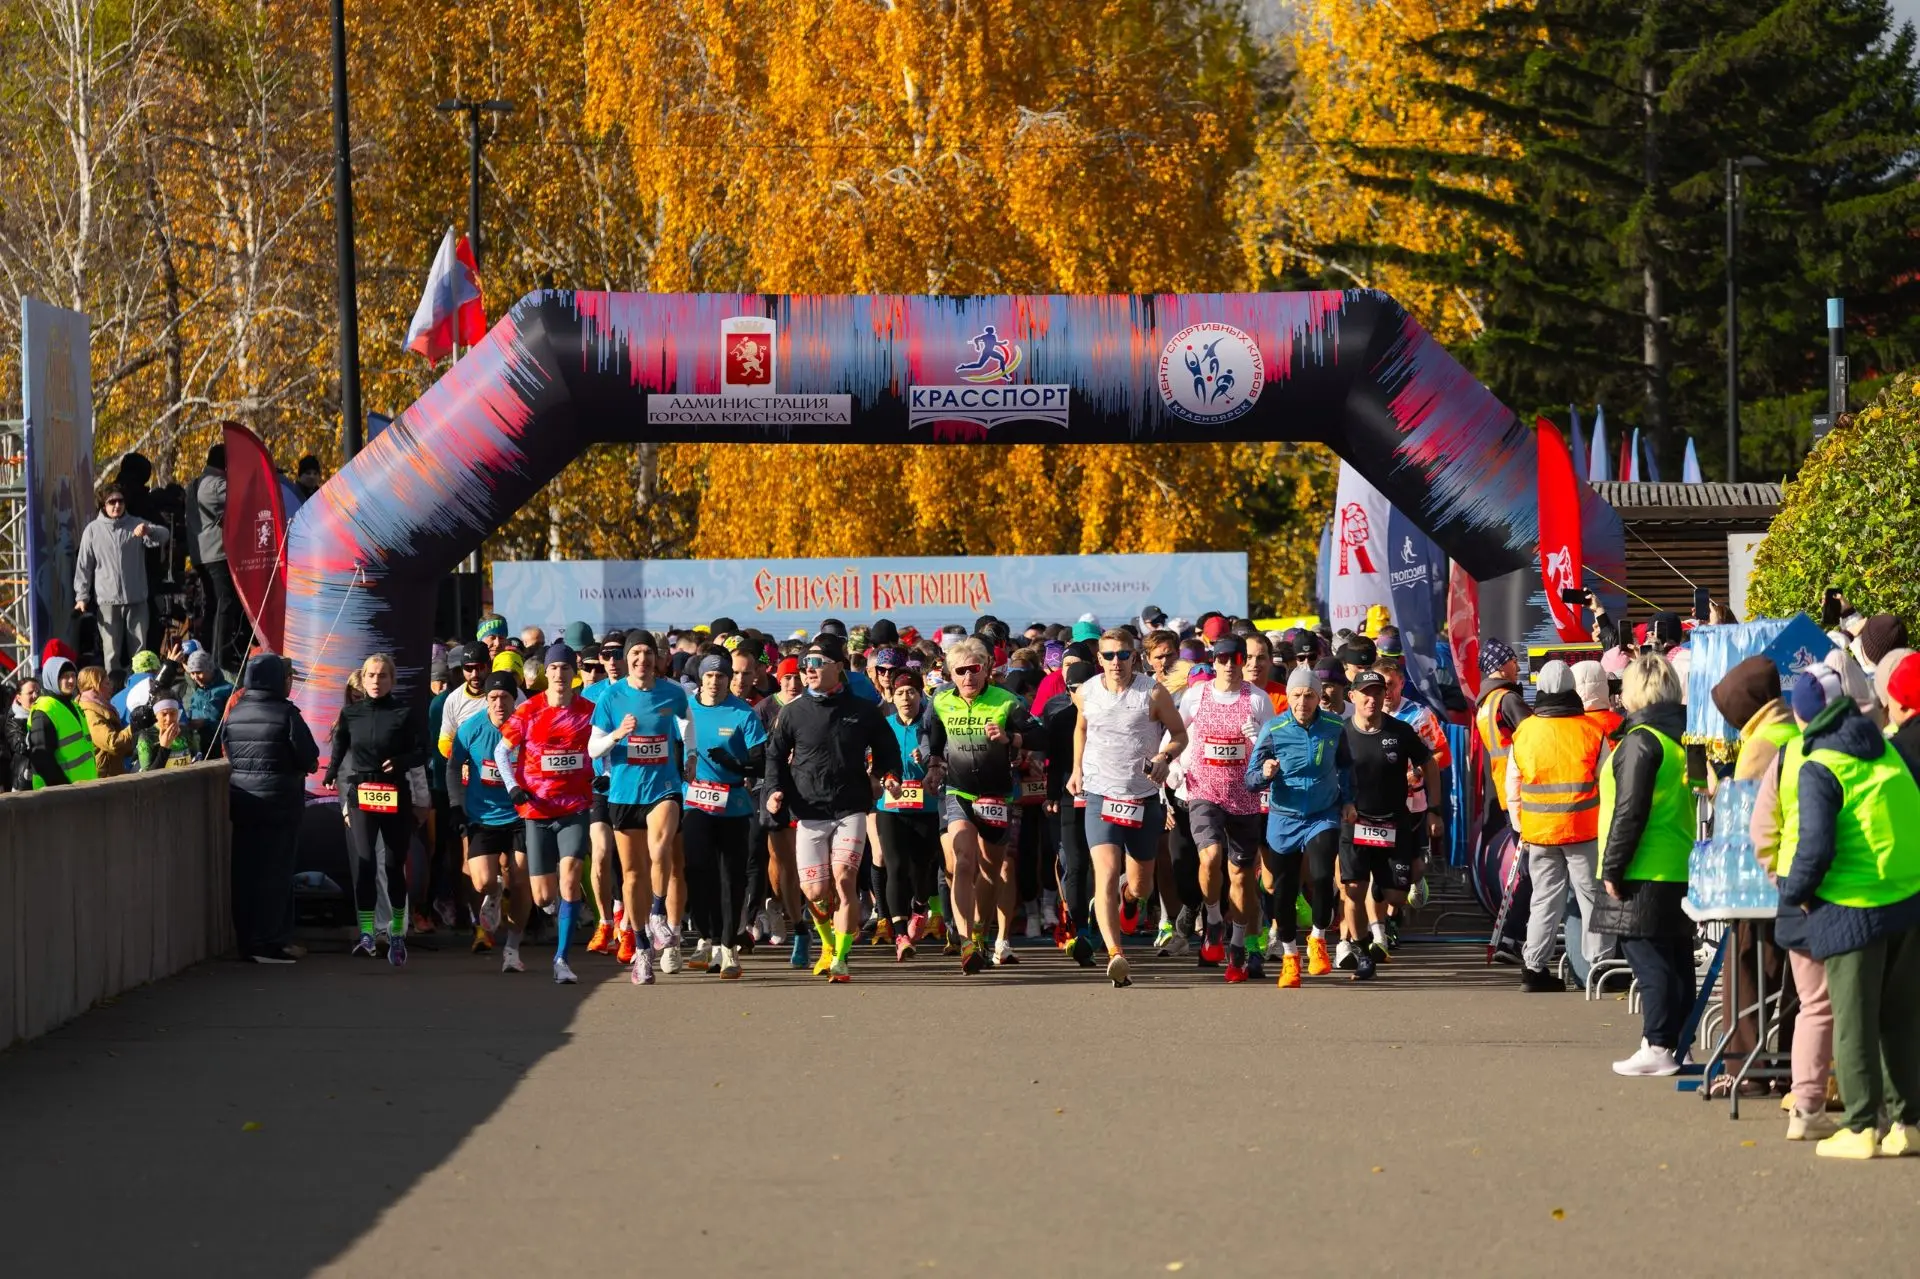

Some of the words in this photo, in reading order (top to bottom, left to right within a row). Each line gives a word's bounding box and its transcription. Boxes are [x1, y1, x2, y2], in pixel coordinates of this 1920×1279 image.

[1166, 323, 1249, 354] СПОРТИВНЫХ
[1247, 343, 1262, 399] КЛУБОВ
[1160, 356, 1173, 401] ЦЕНТР
[669, 397, 829, 411] АДМИНИСТРАЦИЯ
[912, 388, 1068, 408] КРАССПОРТ
[649, 412, 717, 423] ГОРОДА
[721, 412, 847, 423] КРАСНОЯРСКА
[1172, 404, 1249, 422] КРАСНОЯРСК
[579, 587, 695, 601] ПОЛУМАРАФОН
[1052, 581, 1150, 594] КРАСНОЯРСК
[947, 716, 994, 726] RIBBLE
[634, 744, 662, 755] 1015
[1212, 746, 1238, 756] 1212
[547, 756, 577, 767] 1286
[364, 791, 391, 802] 1366
[694, 789, 720, 802] 1016
[980, 805, 1004, 817] 1162
[1110, 802, 1138, 816] 1077
[1362, 827, 1388, 838] 1150
